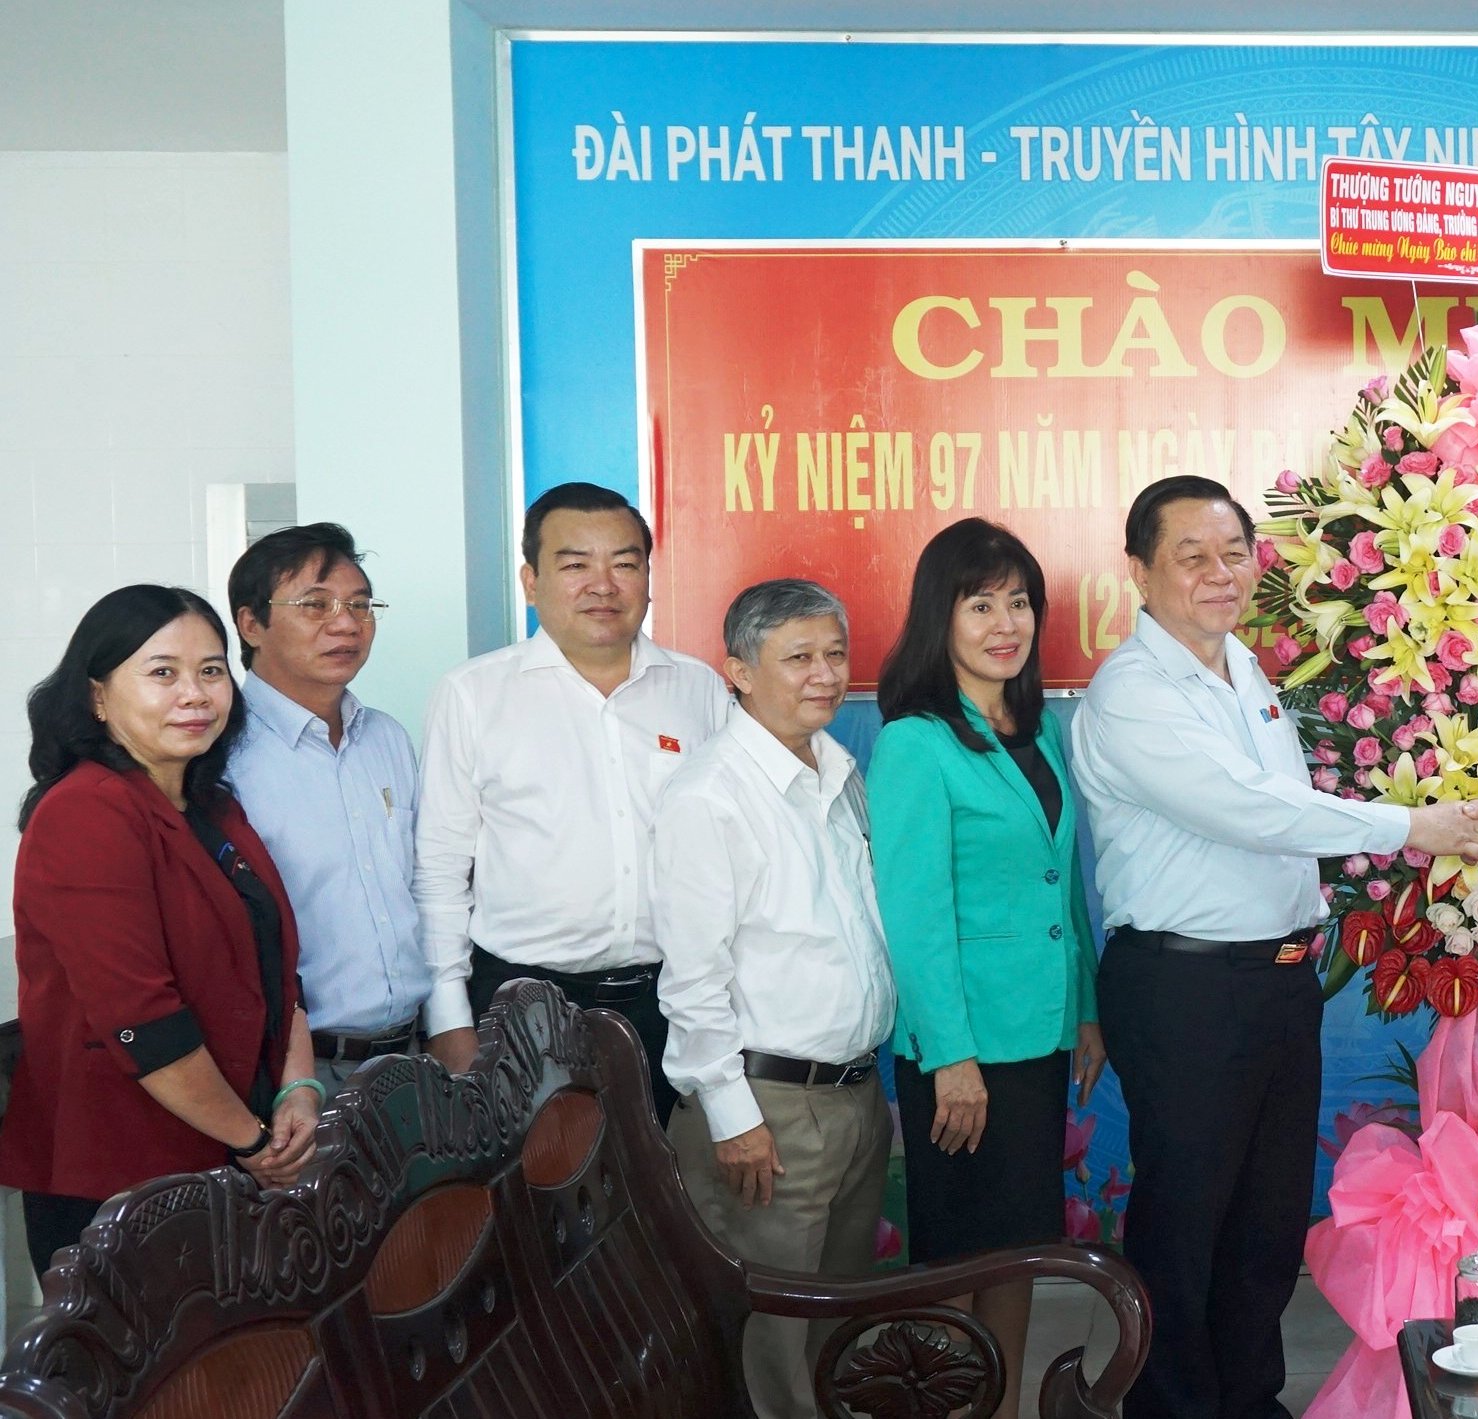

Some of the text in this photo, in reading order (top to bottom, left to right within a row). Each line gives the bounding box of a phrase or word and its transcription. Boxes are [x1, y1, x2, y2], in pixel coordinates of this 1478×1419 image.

[572, 110, 652, 181] ĐÀI
[667, 111, 792, 181] PHÁT
[801, 125, 965, 181] THANH
[1010, 109, 1191, 182] TRUYỀN
[1207, 113, 1316, 181] HÌNH
[1330, 172, 1389, 205] THƯỢNG
[1394, 173, 1441, 206] TƯỚNG
[1329, 206, 1340, 228] BÍ
[1341, 207, 1359, 230] THƯ
[1360, 209, 1389, 231] TRUNG
[1330, 233, 1359, 256] Chúc
[1361, 238, 1394, 261] mừng
[1396, 235, 1431, 263] Ngày
[1434, 237, 1456, 262] Báo
[1460, 241, 1477, 261] chí
[891, 270, 1287, 380] CHÀO
[724, 404, 779, 511] KỶ
[797, 414, 914, 530] NIỆM
[929, 432, 982, 511] 97
[1000, 413, 1100, 508] NĂM
